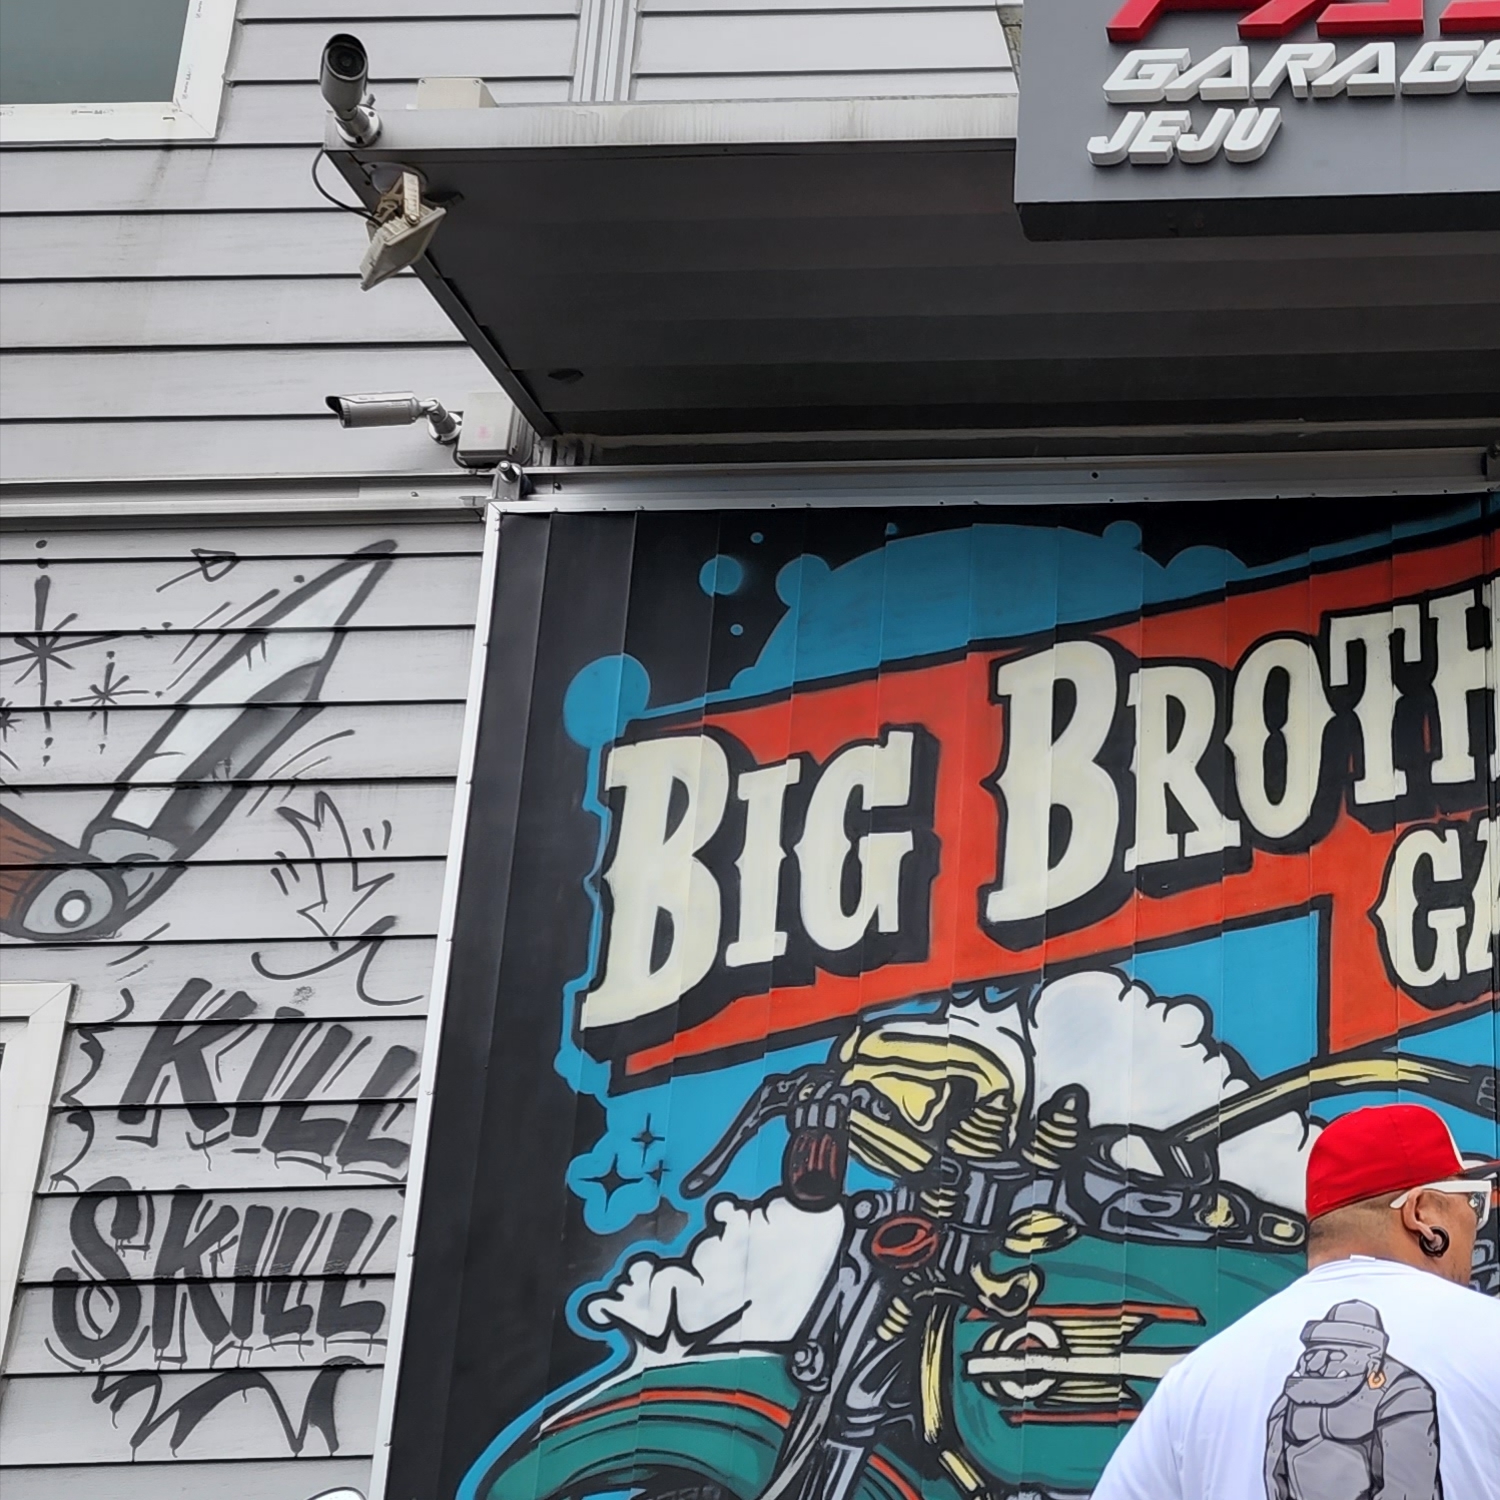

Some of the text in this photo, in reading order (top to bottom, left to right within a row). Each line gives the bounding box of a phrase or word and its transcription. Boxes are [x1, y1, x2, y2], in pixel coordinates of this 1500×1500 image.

[1087, 107, 1282, 165] JEJU
[580, 730, 916, 1030] BIG
[118, 977, 418, 1172] KILL
[52, 1176, 388, 1362] SKILL
